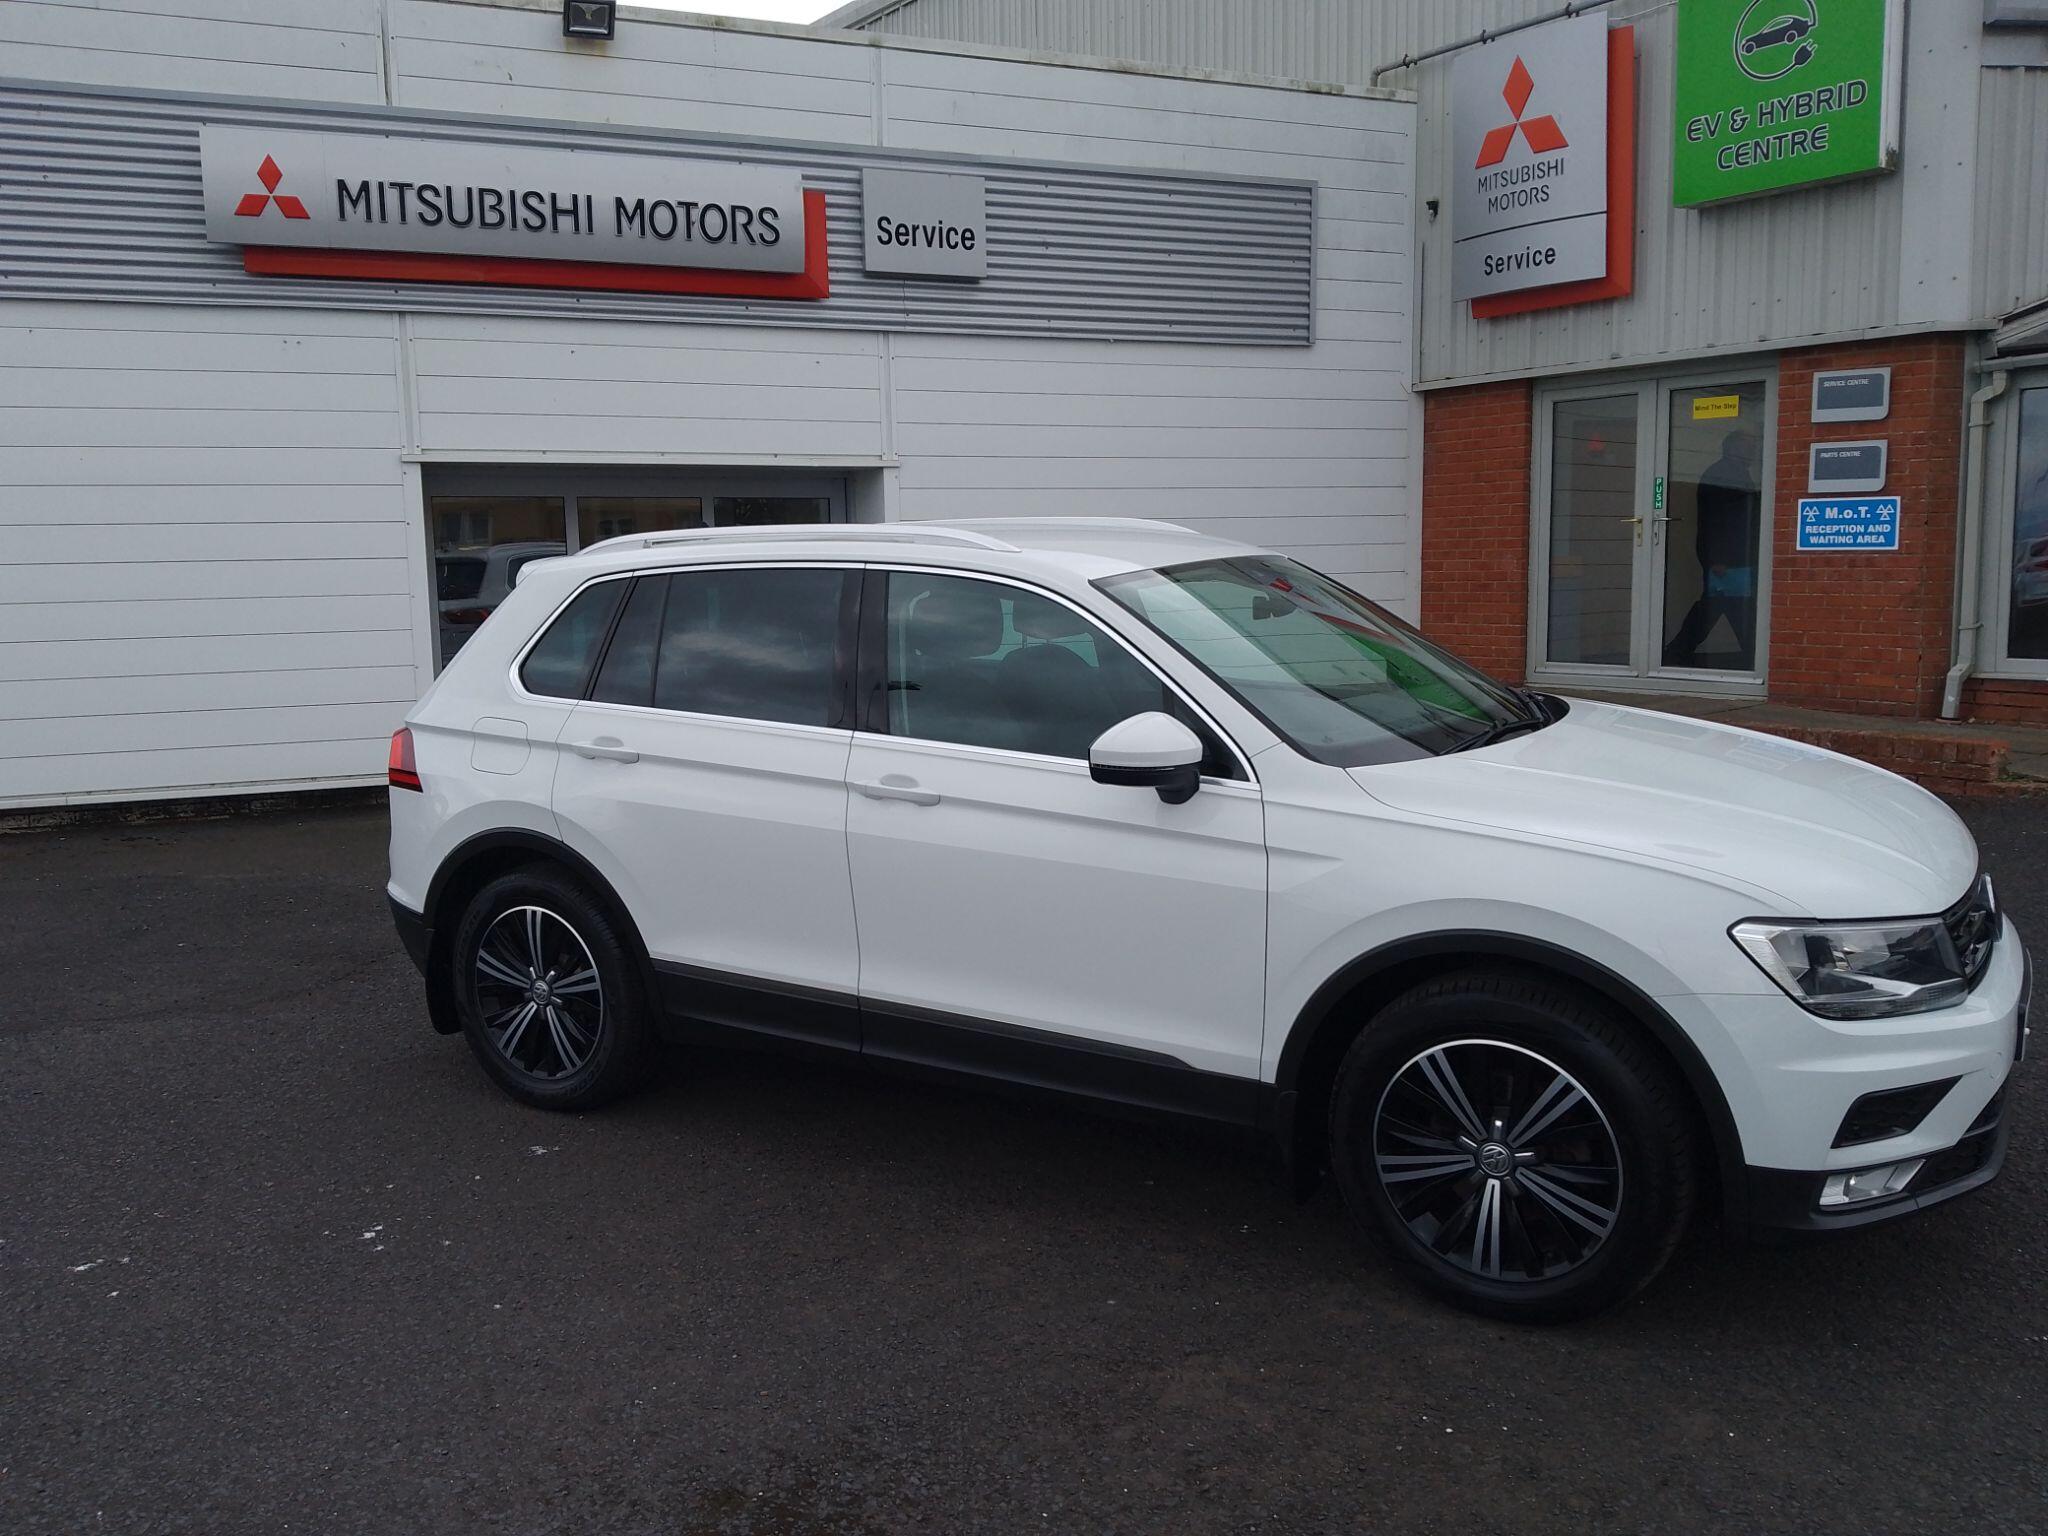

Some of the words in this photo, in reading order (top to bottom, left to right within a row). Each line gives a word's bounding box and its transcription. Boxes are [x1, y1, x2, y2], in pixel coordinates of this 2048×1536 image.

[1686, 111, 1724, 142] EV
[1729, 107, 1750, 133] &
[1757, 79, 1868, 128] HYBRID
[1716, 123, 1829, 171] CENTRE
[1477, 157, 1565, 195] MITSUBISHI
[336, 178, 595, 235] MITSUBISHI
[614, 195, 781, 247] MOTORS
[1488, 184, 1550, 214] MOTORS
[876, 215, 976, 251] Service
[1483, 246, 1556, 276] Service
[1655, 478, 1663, 509] PUSH
[1825, 506, 1872, 519] M.o.T.
[1805, 524, 1865, 534] RECEPTION
[1867, 523, 1892, 533] AND
[1809, 535, 1854, 544] WAITING
[1856, 534, 1886, 543] AREA
